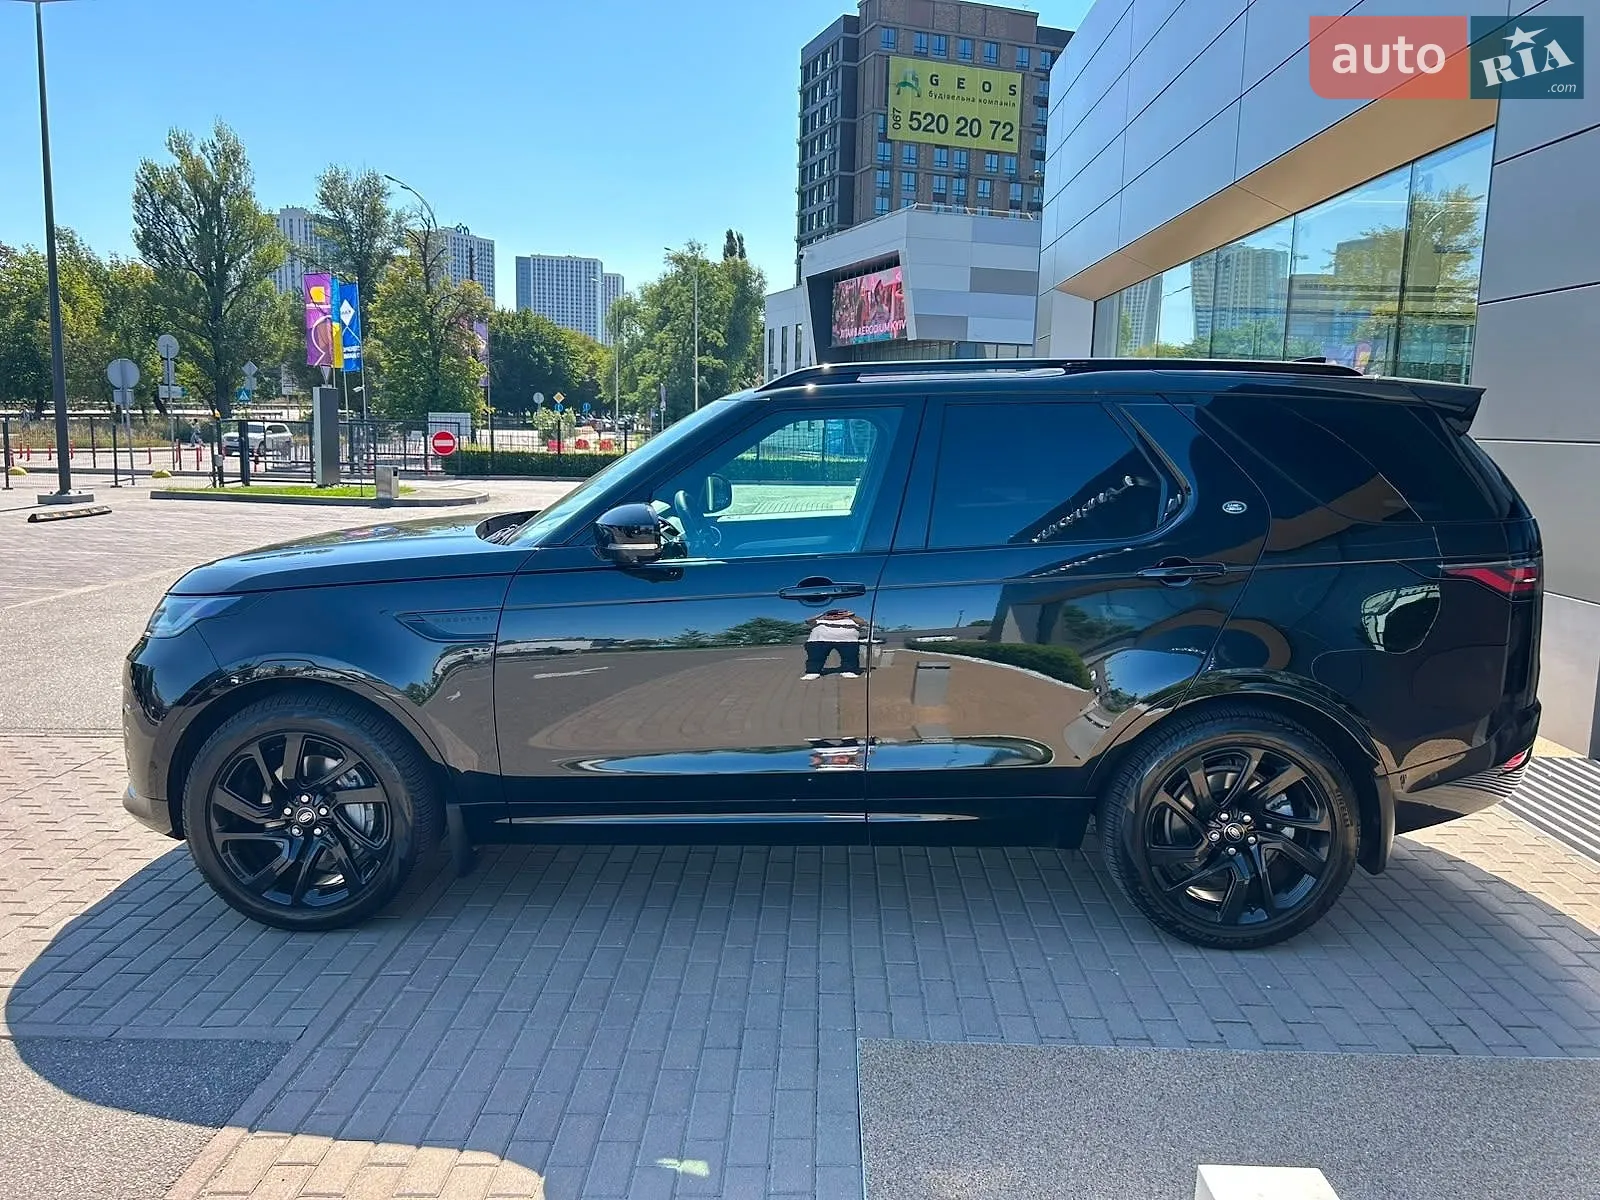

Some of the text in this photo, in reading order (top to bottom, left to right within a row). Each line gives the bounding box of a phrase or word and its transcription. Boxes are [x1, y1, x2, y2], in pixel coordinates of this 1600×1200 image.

[929, 74, 1017, 96] GEOS
[928, 90, 1016, 108] будівельна компанія
[892, 107, 902, 130] 067
[908, 110, 1014, 142] 520 20 72
